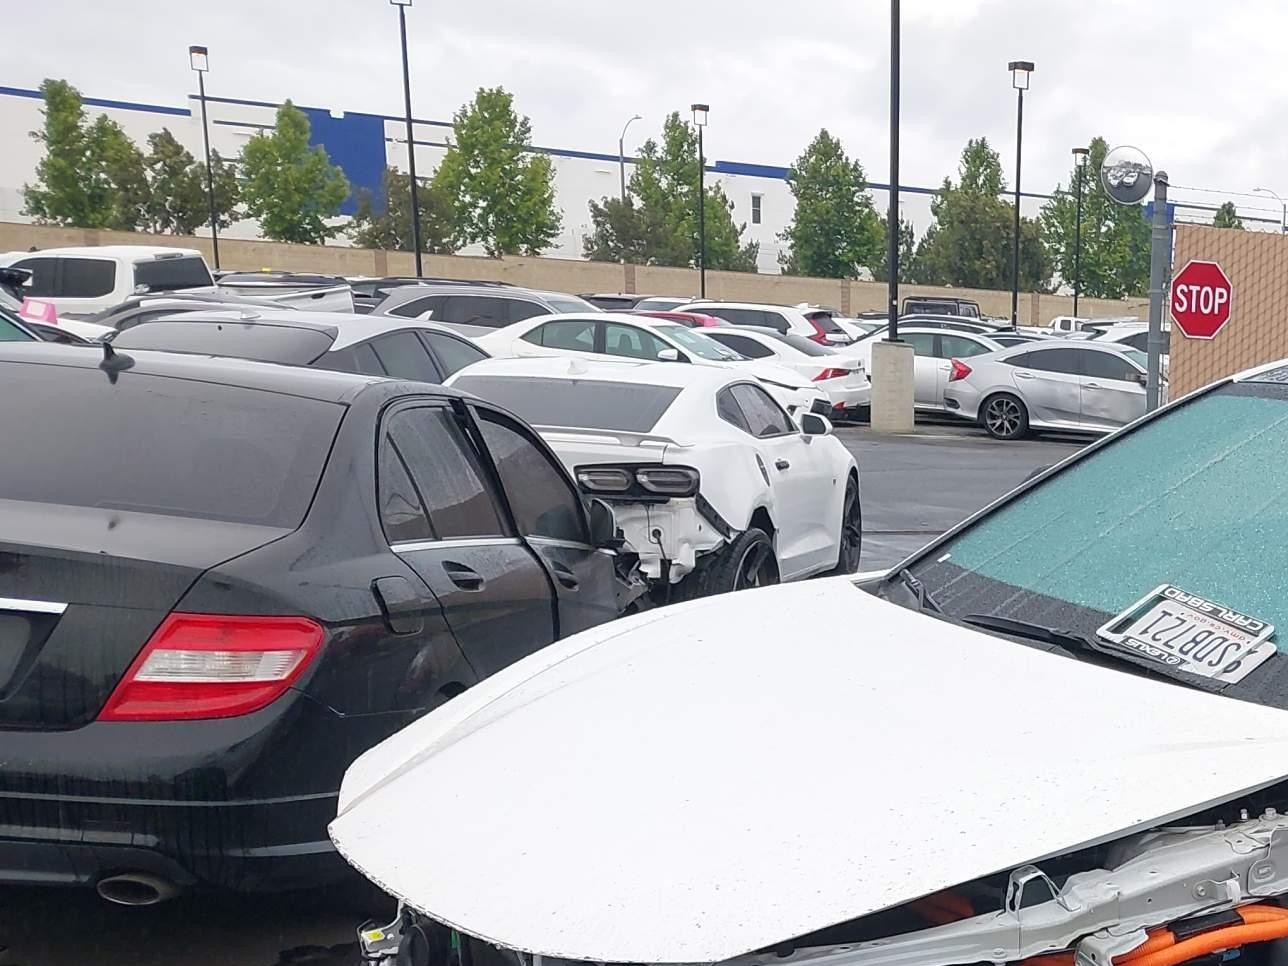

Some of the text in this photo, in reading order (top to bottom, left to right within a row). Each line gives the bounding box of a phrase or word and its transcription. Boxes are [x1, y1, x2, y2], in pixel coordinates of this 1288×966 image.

[1174, 283, 1228, 315] STOP
[1164, 586, 1264, 632] CARLSBAD
[1124, 638, 1171, 662] LEXUS
